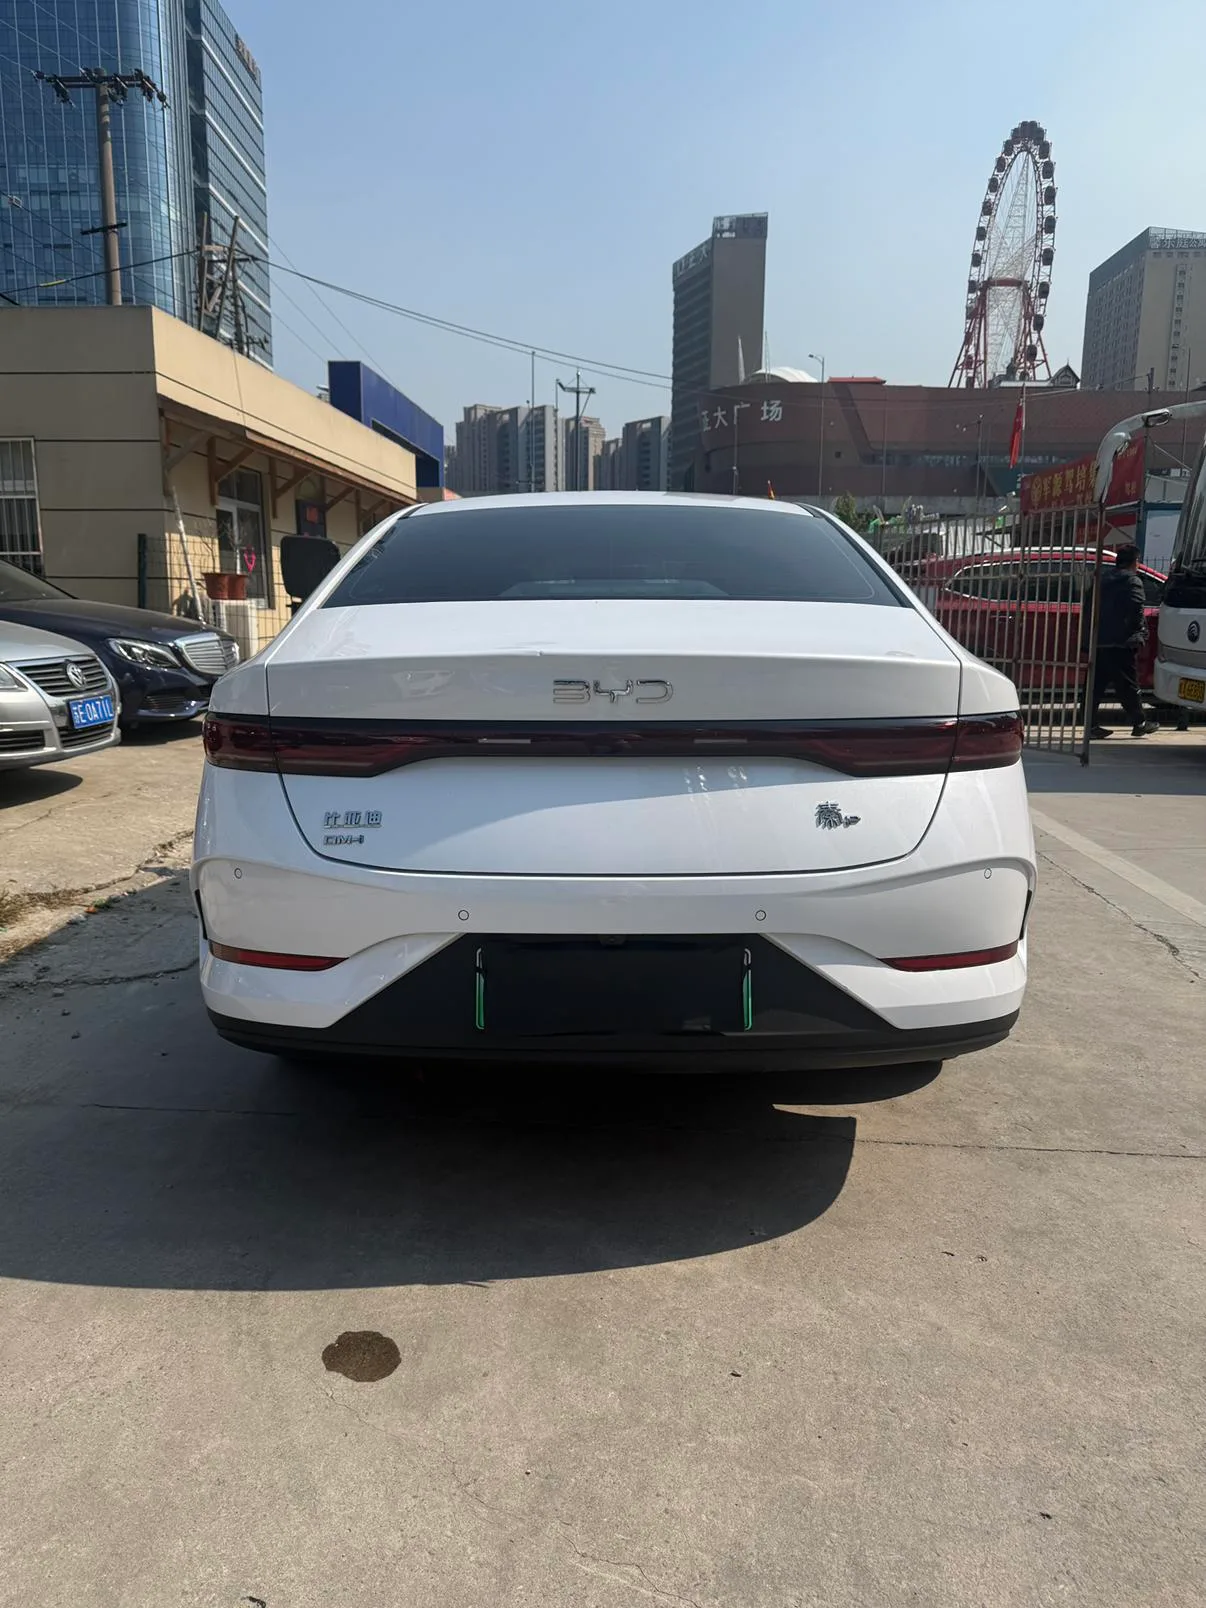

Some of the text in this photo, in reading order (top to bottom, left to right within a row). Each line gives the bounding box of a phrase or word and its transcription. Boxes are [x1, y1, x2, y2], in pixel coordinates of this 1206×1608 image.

[553, 680, 674, 704] BYD
[324, 810, 382, 828] 比亚迪
